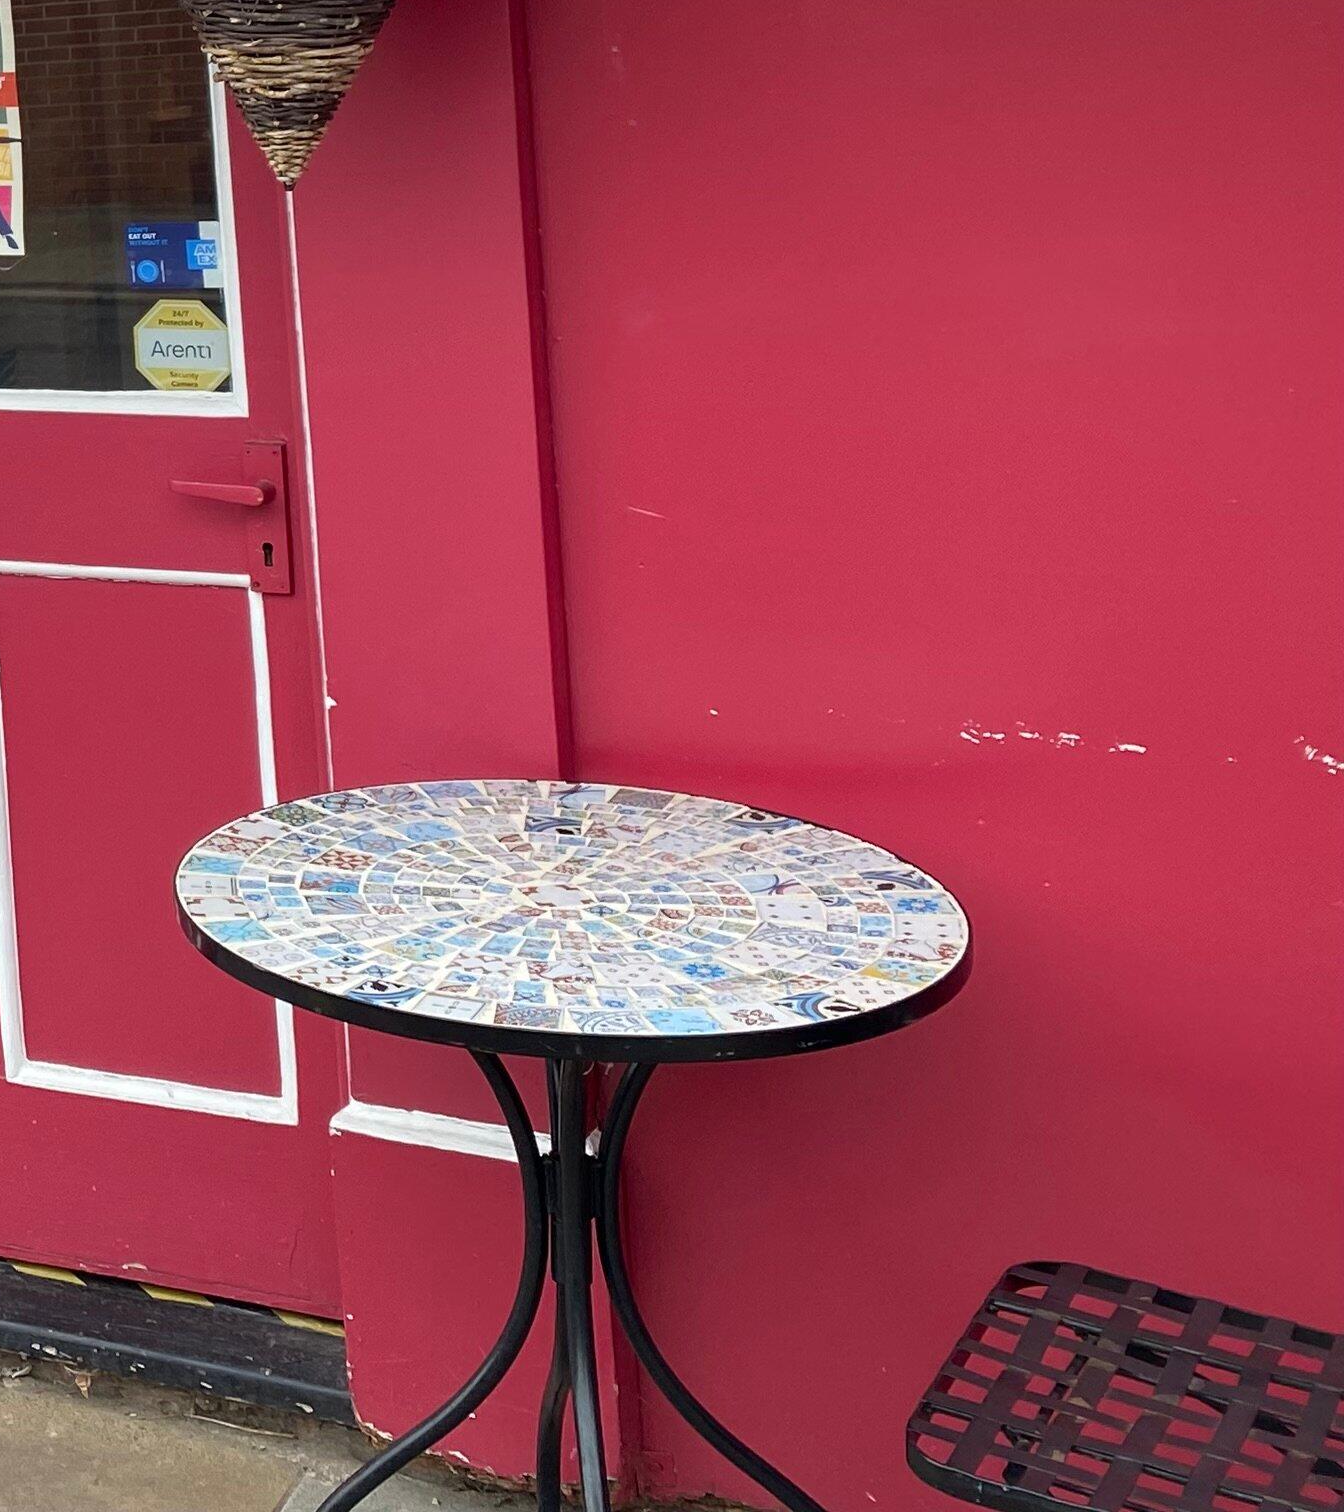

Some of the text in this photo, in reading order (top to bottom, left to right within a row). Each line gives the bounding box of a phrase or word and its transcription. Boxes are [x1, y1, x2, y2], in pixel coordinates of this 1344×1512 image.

[194, 243, 216, 256] AM
[198, 254, 216, 265] EX
[172, 310, 189, 318] 24/7
[158, 319, 204, 328] Protected by
[151, 340, 212, 359] Arenti
[169, 371, 199, 380] Security
